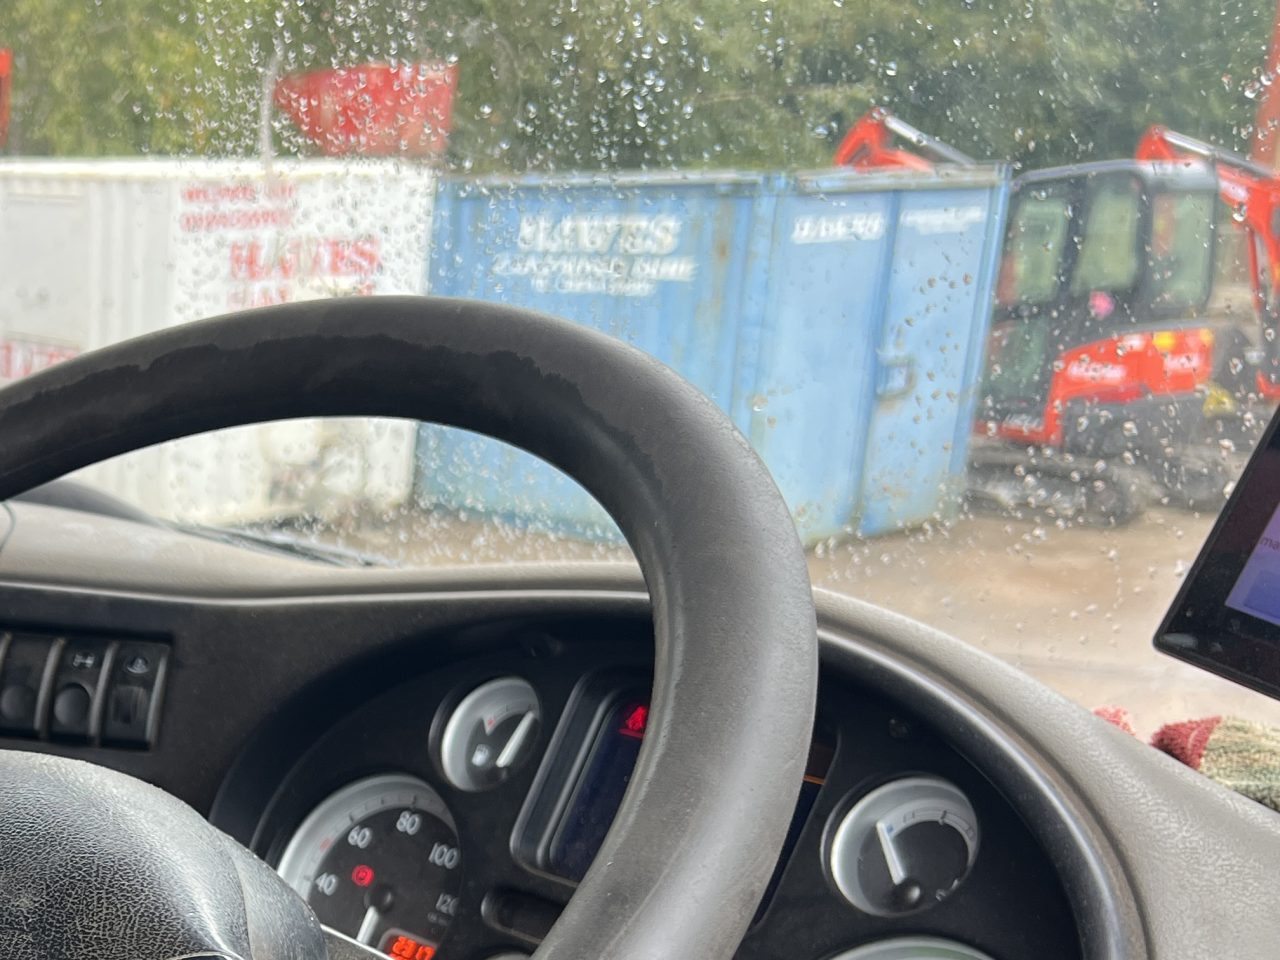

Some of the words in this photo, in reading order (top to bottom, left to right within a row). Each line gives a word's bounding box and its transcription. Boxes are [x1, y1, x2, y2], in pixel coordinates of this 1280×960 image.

[396, 810, 421, 835] 80
[347, 825, 371, 849] 60
[428, 841, 460, 869] 100
[315, 872, 338, 896] 40
